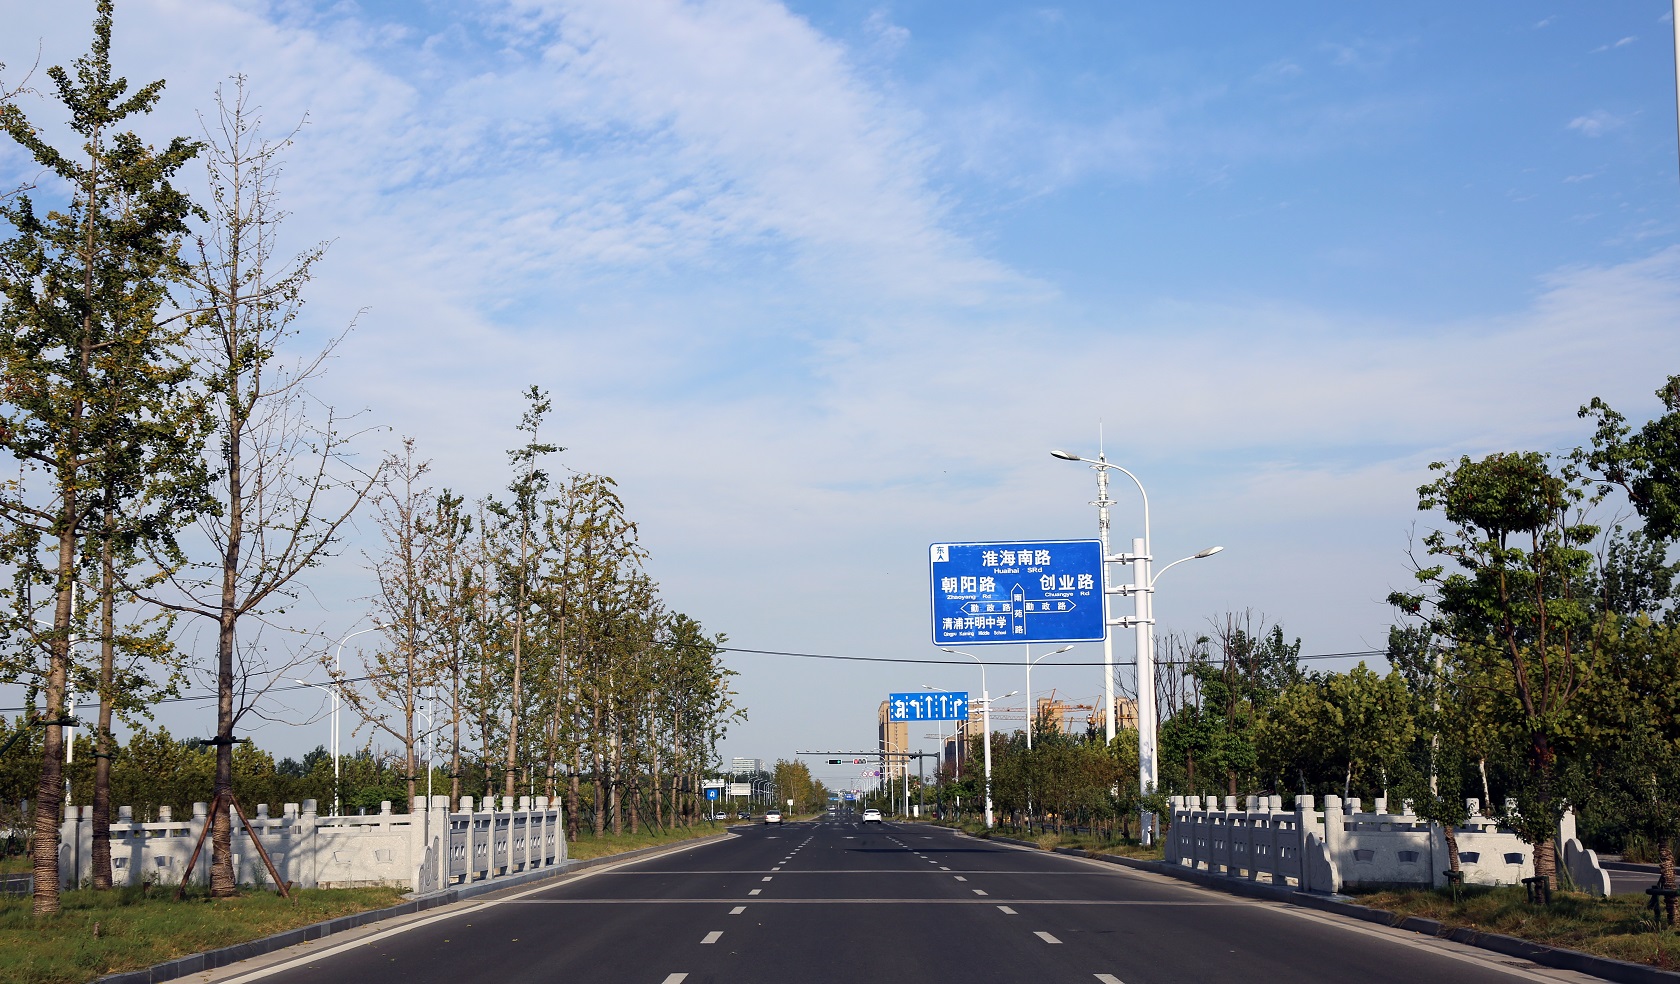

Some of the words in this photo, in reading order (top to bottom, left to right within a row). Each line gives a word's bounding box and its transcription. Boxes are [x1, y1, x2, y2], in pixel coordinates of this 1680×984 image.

[936, 546, 945, 554] 东
[982, 549, 1051, 567] 淮海南路
[941, 576, 996, 593] 朝阳路
[1040, 573, 1094, 591] 创业路
[942, 616, 1007, 630] 清浦开明中学
